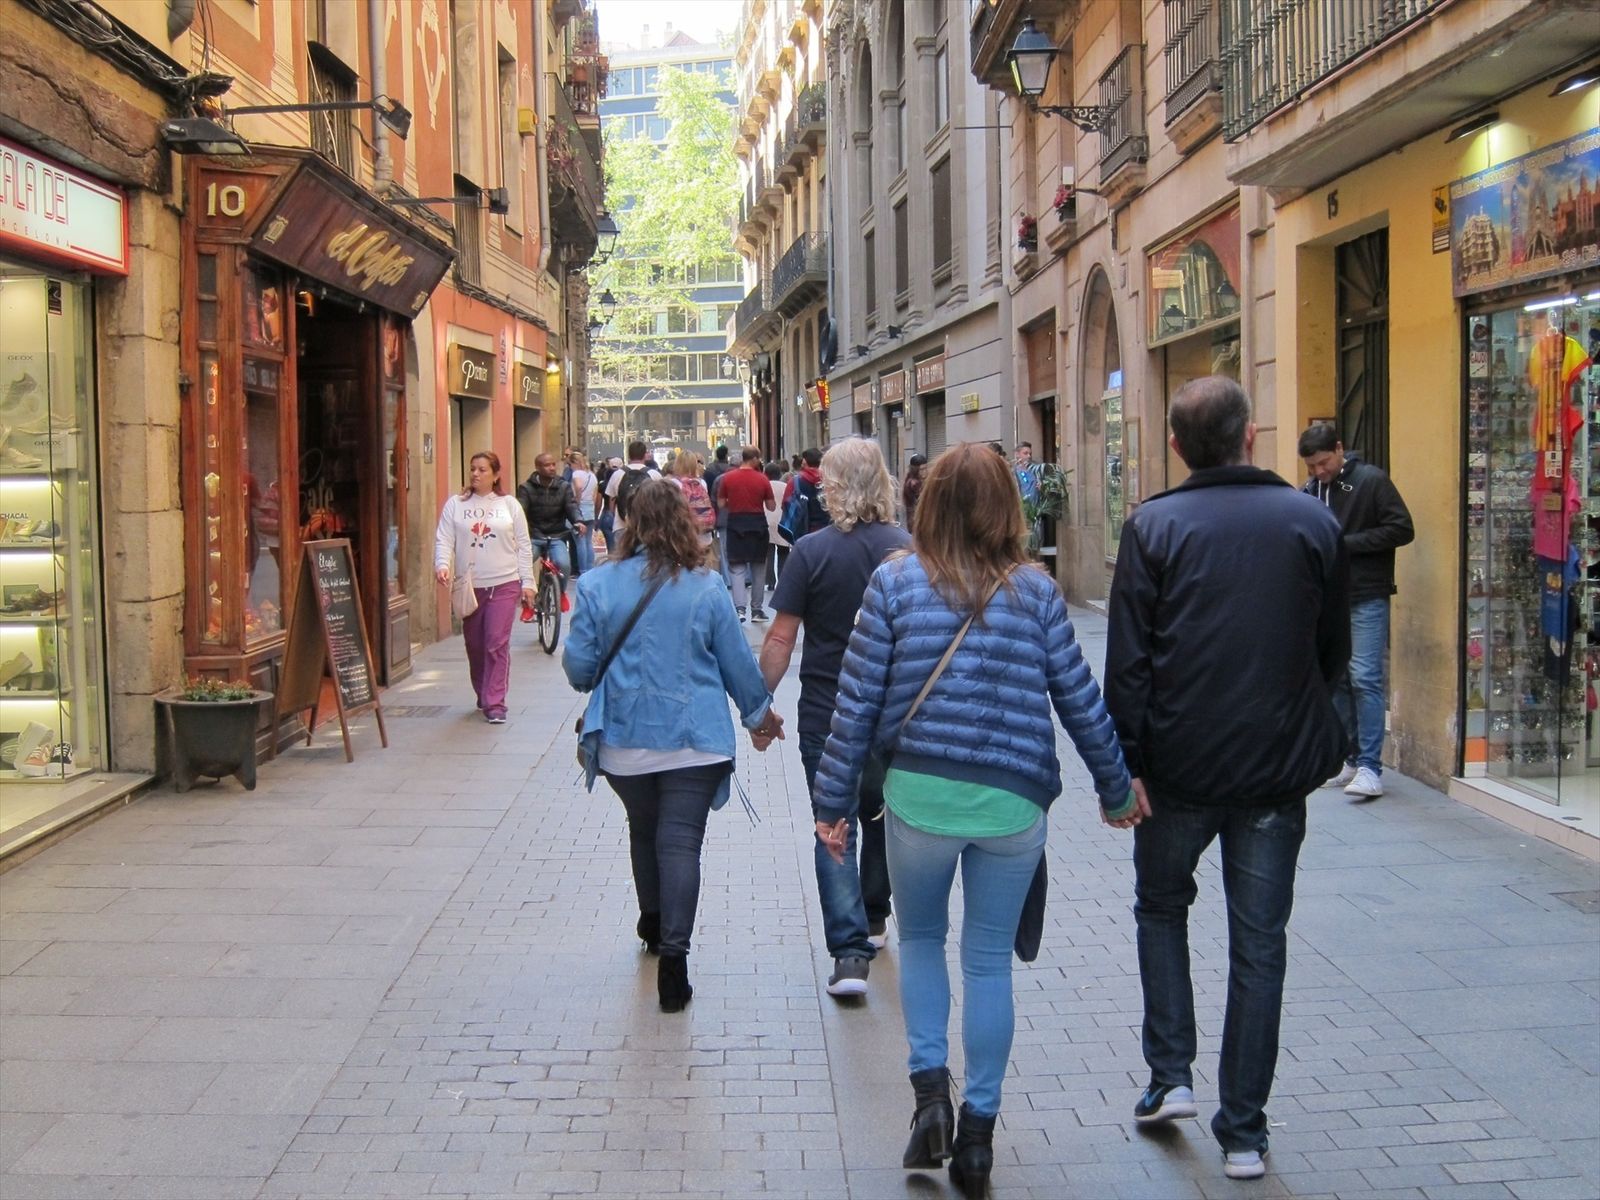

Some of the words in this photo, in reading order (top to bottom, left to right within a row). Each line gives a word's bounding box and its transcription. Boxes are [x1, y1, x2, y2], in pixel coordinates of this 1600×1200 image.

[43, 167, 69, 225] DEI
[207, 182, 246, 217] 10
[463, 507, 504, 520] ROSE
